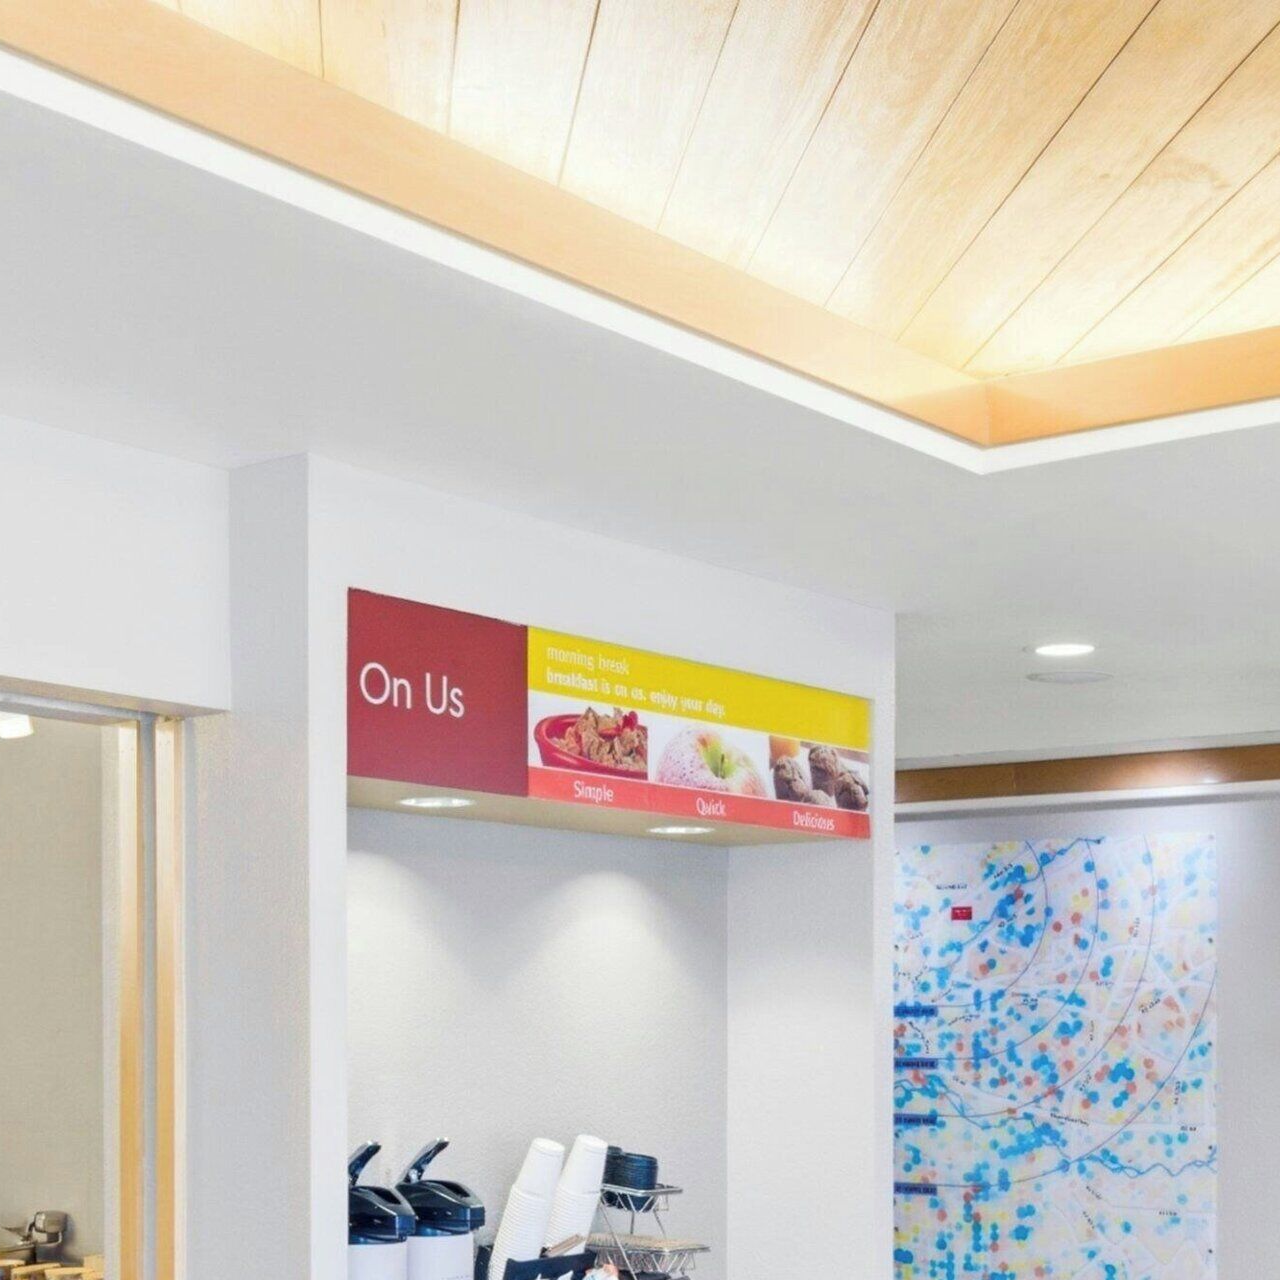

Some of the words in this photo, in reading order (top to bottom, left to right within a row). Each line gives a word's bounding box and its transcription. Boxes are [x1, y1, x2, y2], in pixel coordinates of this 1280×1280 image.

[547, 647, 594, 671] morning
[598, 653, 630, 675] break
[360, 662, 412, 709] On
[425, 672, 465, 718] Us
[546, 667, 598, 692] breakfast
[600, 682, 611, 695] is
[615, 685, 627, 698] on
[650, 689, 678, 710] enjoy
[680, 696, 703, 712] your
[574, 780, 614, 804] Simple
[696, 797, 727, 818] Quick
[793, 810, 836, 831] Delicious
